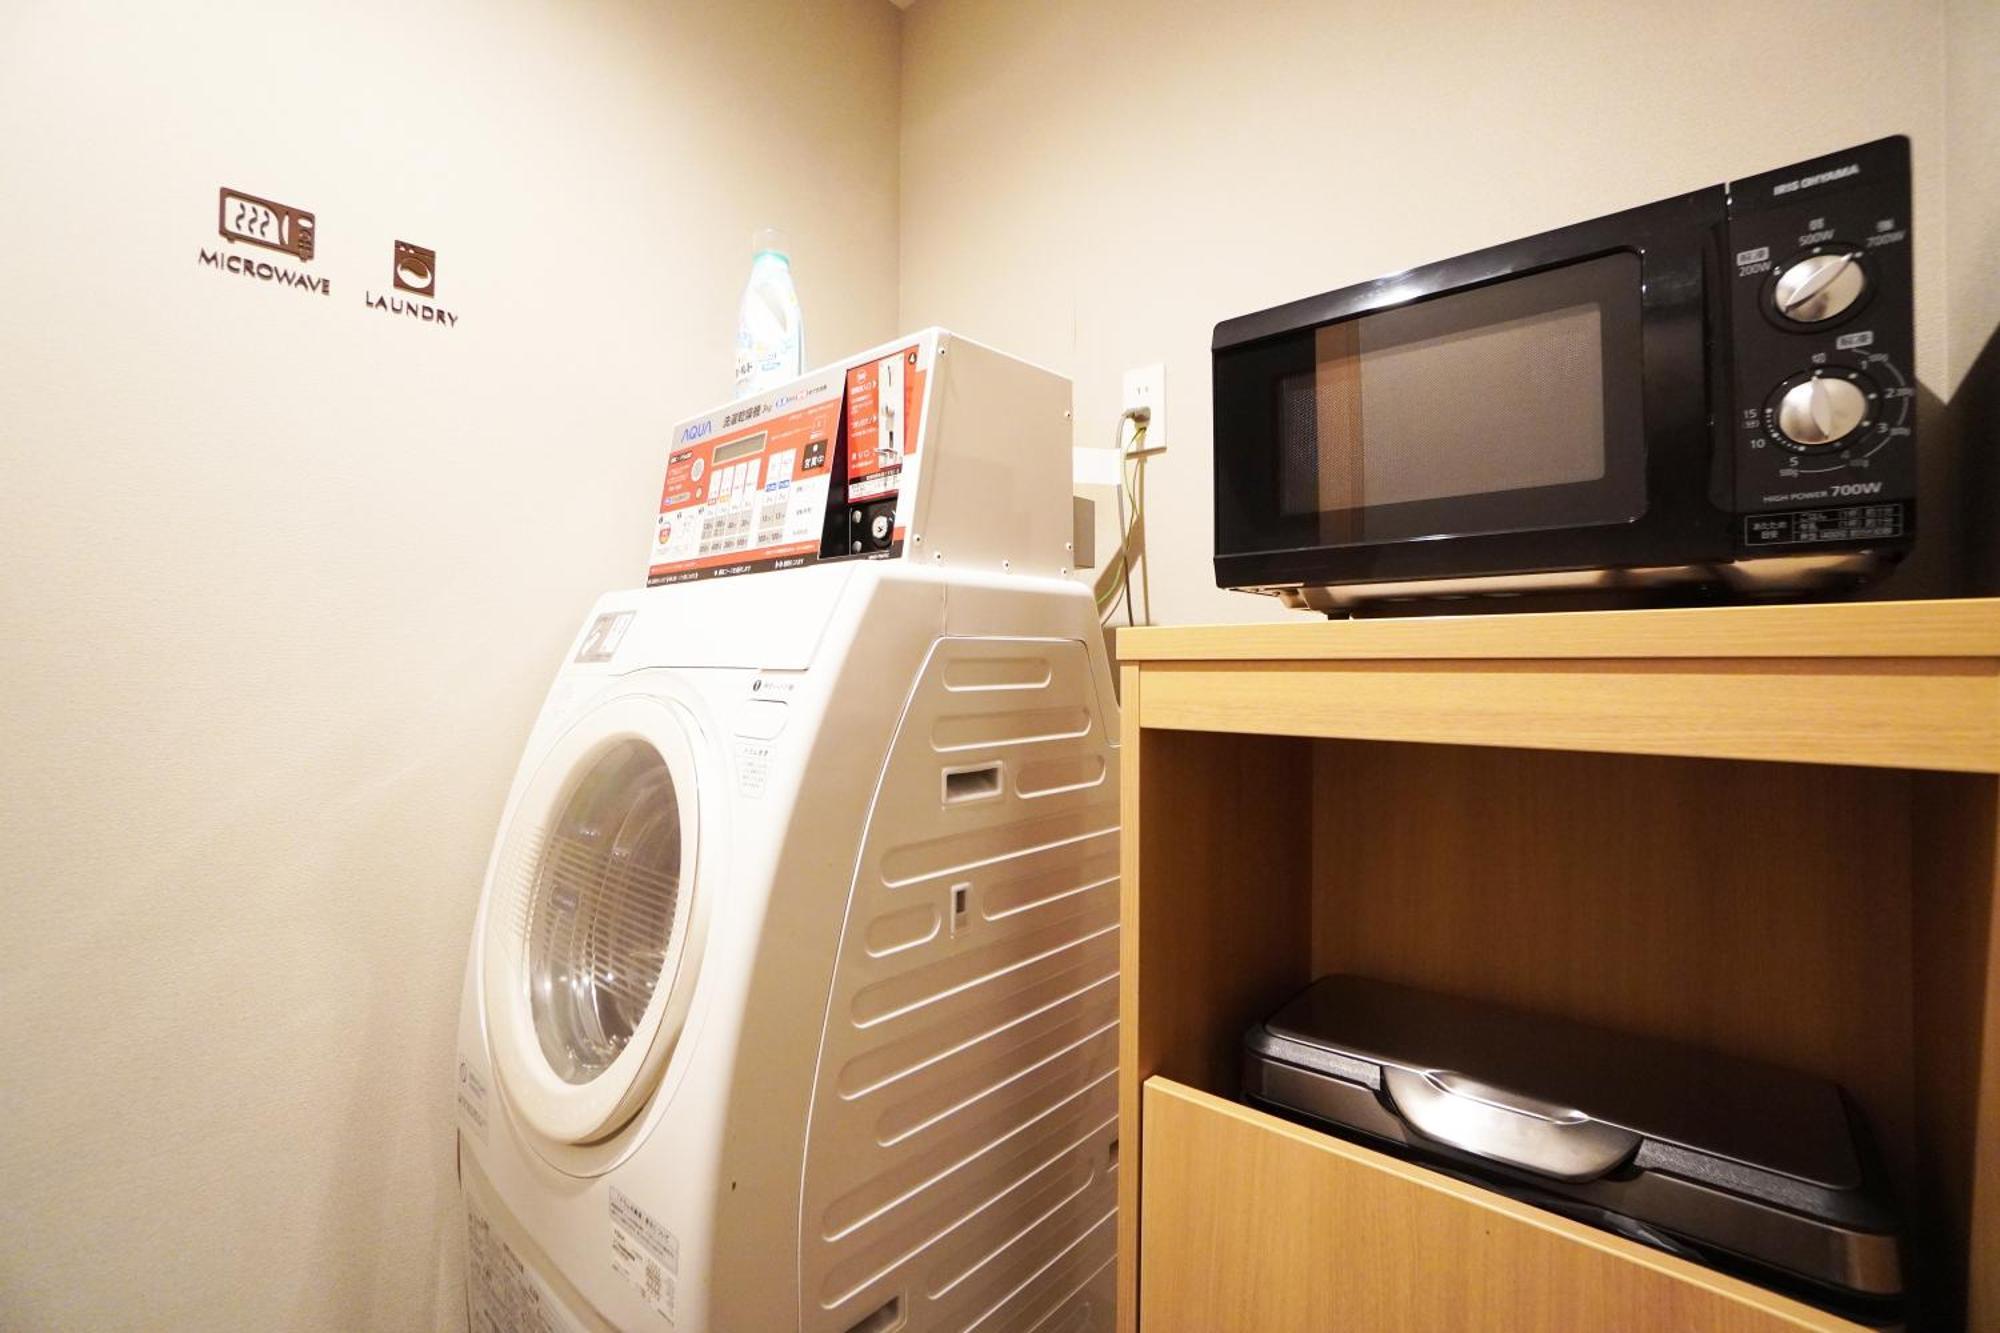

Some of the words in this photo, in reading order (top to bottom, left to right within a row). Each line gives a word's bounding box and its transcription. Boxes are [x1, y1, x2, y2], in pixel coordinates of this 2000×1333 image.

[1773, 180, 1799, 196] IRIS
[1801, 163, 1860, 188] OHYAMA
[1799, 229, 1835, 247] 500W
[199, 247, 330, 296] MICROWAVE
[1739, 260, 1772, 277] 200W
[366, 291, 458, 328] LAUNDRY
[1744, 408, 1758, 419] 15
[681, 420, 712, 443] AQUA
[1877, 422, 1889, 433] 3
[1750, 438, 1766, 449] 10
[1789, 456, 1799, 467] 5
[1763, 494, 1788, 503] HIGH
[1790, 490, 1828, 501] POWER
[1830, 481, 1883, 497] 700W
